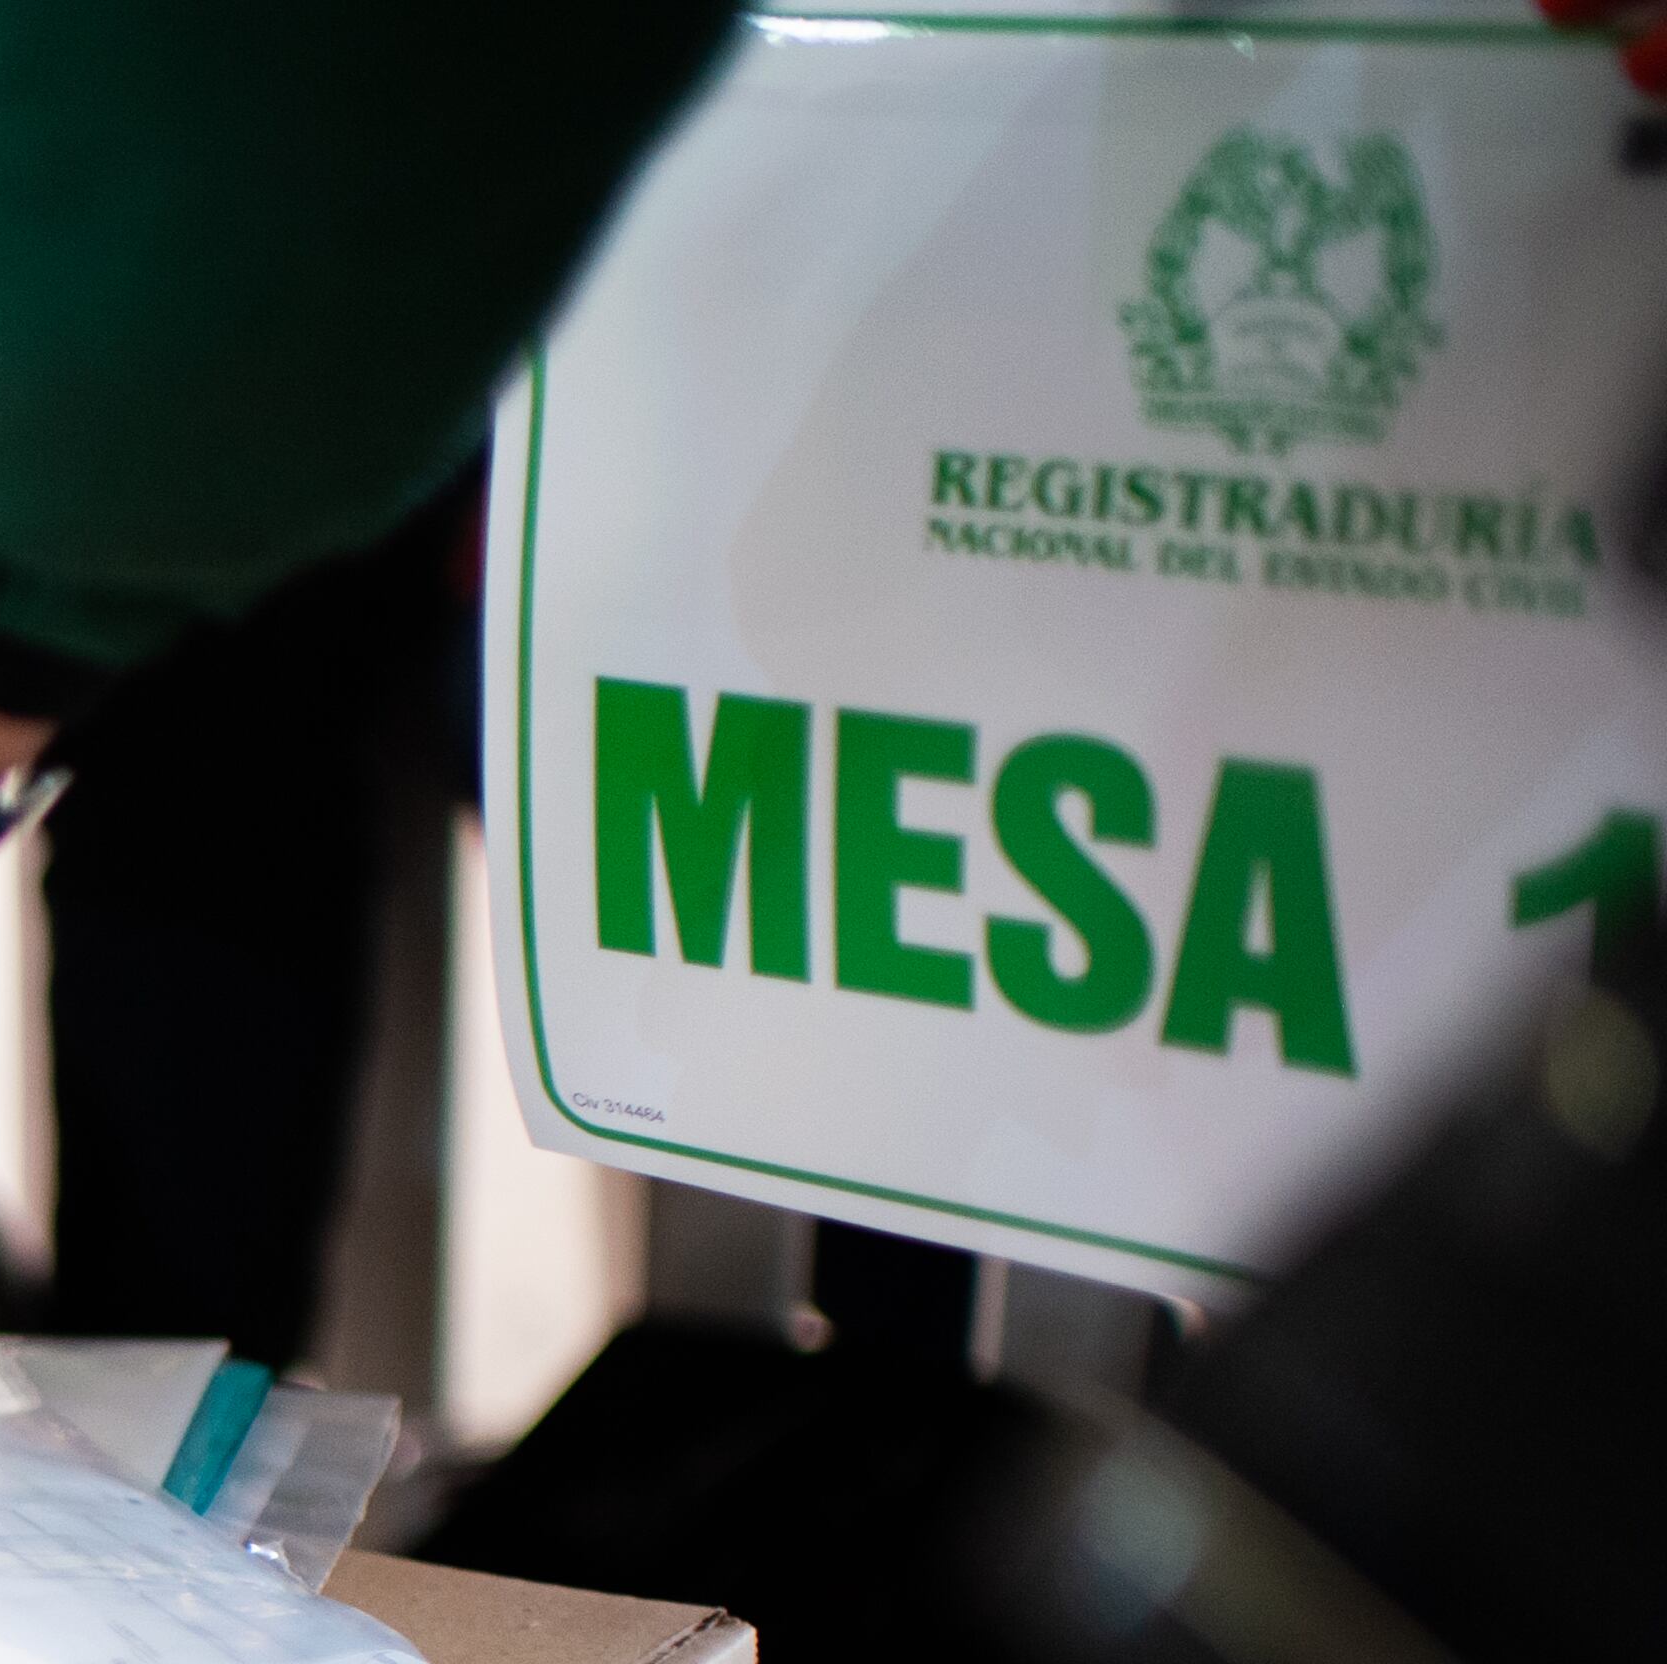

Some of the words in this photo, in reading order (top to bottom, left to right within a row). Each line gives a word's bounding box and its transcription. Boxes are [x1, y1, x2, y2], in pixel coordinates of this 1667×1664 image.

[926, 516, 1139, 573] NACIONAL
[1155, 540, 1243, 585] DEL
[593, 675, 1357, 1080] MESA
